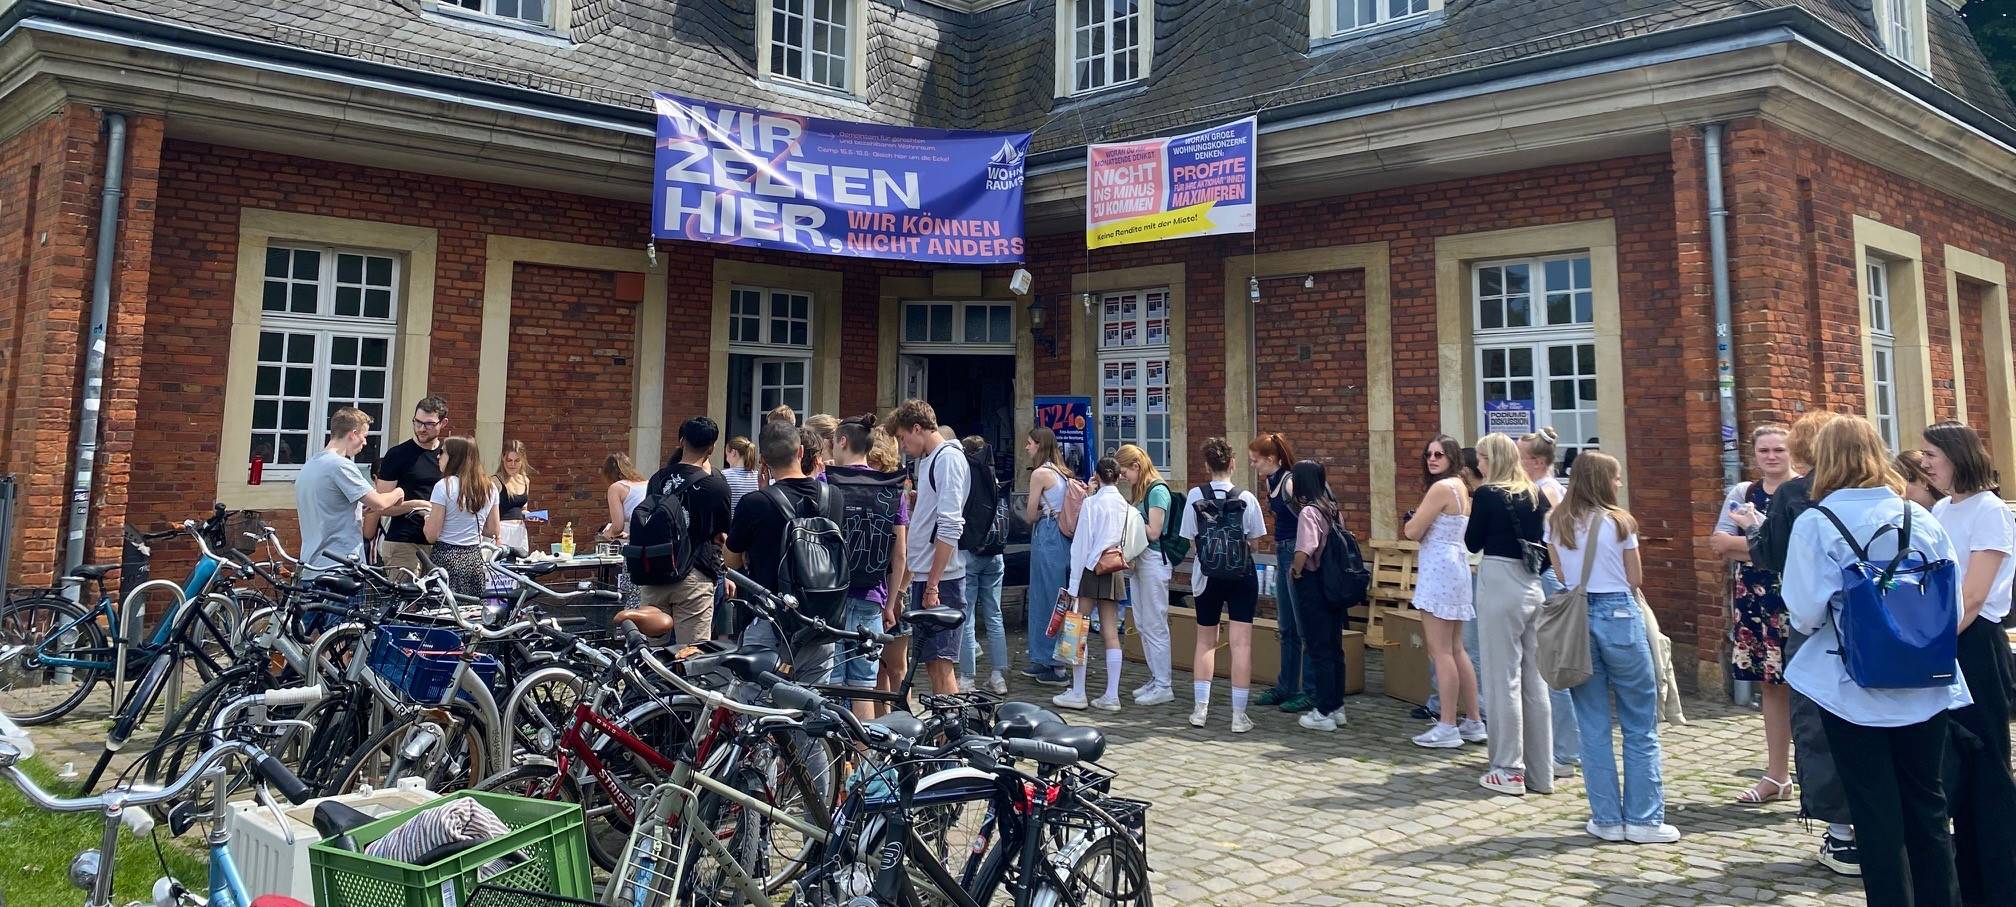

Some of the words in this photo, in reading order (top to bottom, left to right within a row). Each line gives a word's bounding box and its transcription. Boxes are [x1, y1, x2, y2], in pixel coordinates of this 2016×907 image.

[675, 105, 804, 157] WIR
[1184, 134, 1210, 145] WORAN
[1172, 136, 1247, 155] WOHNUNGSKONZERNE
[666, 137, 920, 209] ZELTEN
[987, 165, 1024, 181] WOHN
[1094, 162, 1156, 187] NICHT
[1173, 156, 1246, 183] PROFITE
[985, 175, 1025, 191] RAUM?
[1094, 186, 1111, 202] INS
[1113, 182, 1155, 199] MINUS
[1094, 201, 1104, 218] ZU
[1106, 196, 1154, 215] KOMMEN
[1172, 183, 1246, 208] MAXIMIEREN
[664, 186, 843, 253] HIER,
[848, 210, 896, 233] WIR
[902, 212, 1001, 239] KÖNNEN
[1115, 226, 1142, 237] Rendite
[1143, 222, 1156, 231] mit
[1173, 214, 1198, 225] Miete!
[847, 233, 921, 255] NICHT
[927, 237, 1025, 257] ANDERS
[705, 837, 744, 881] SWAP
